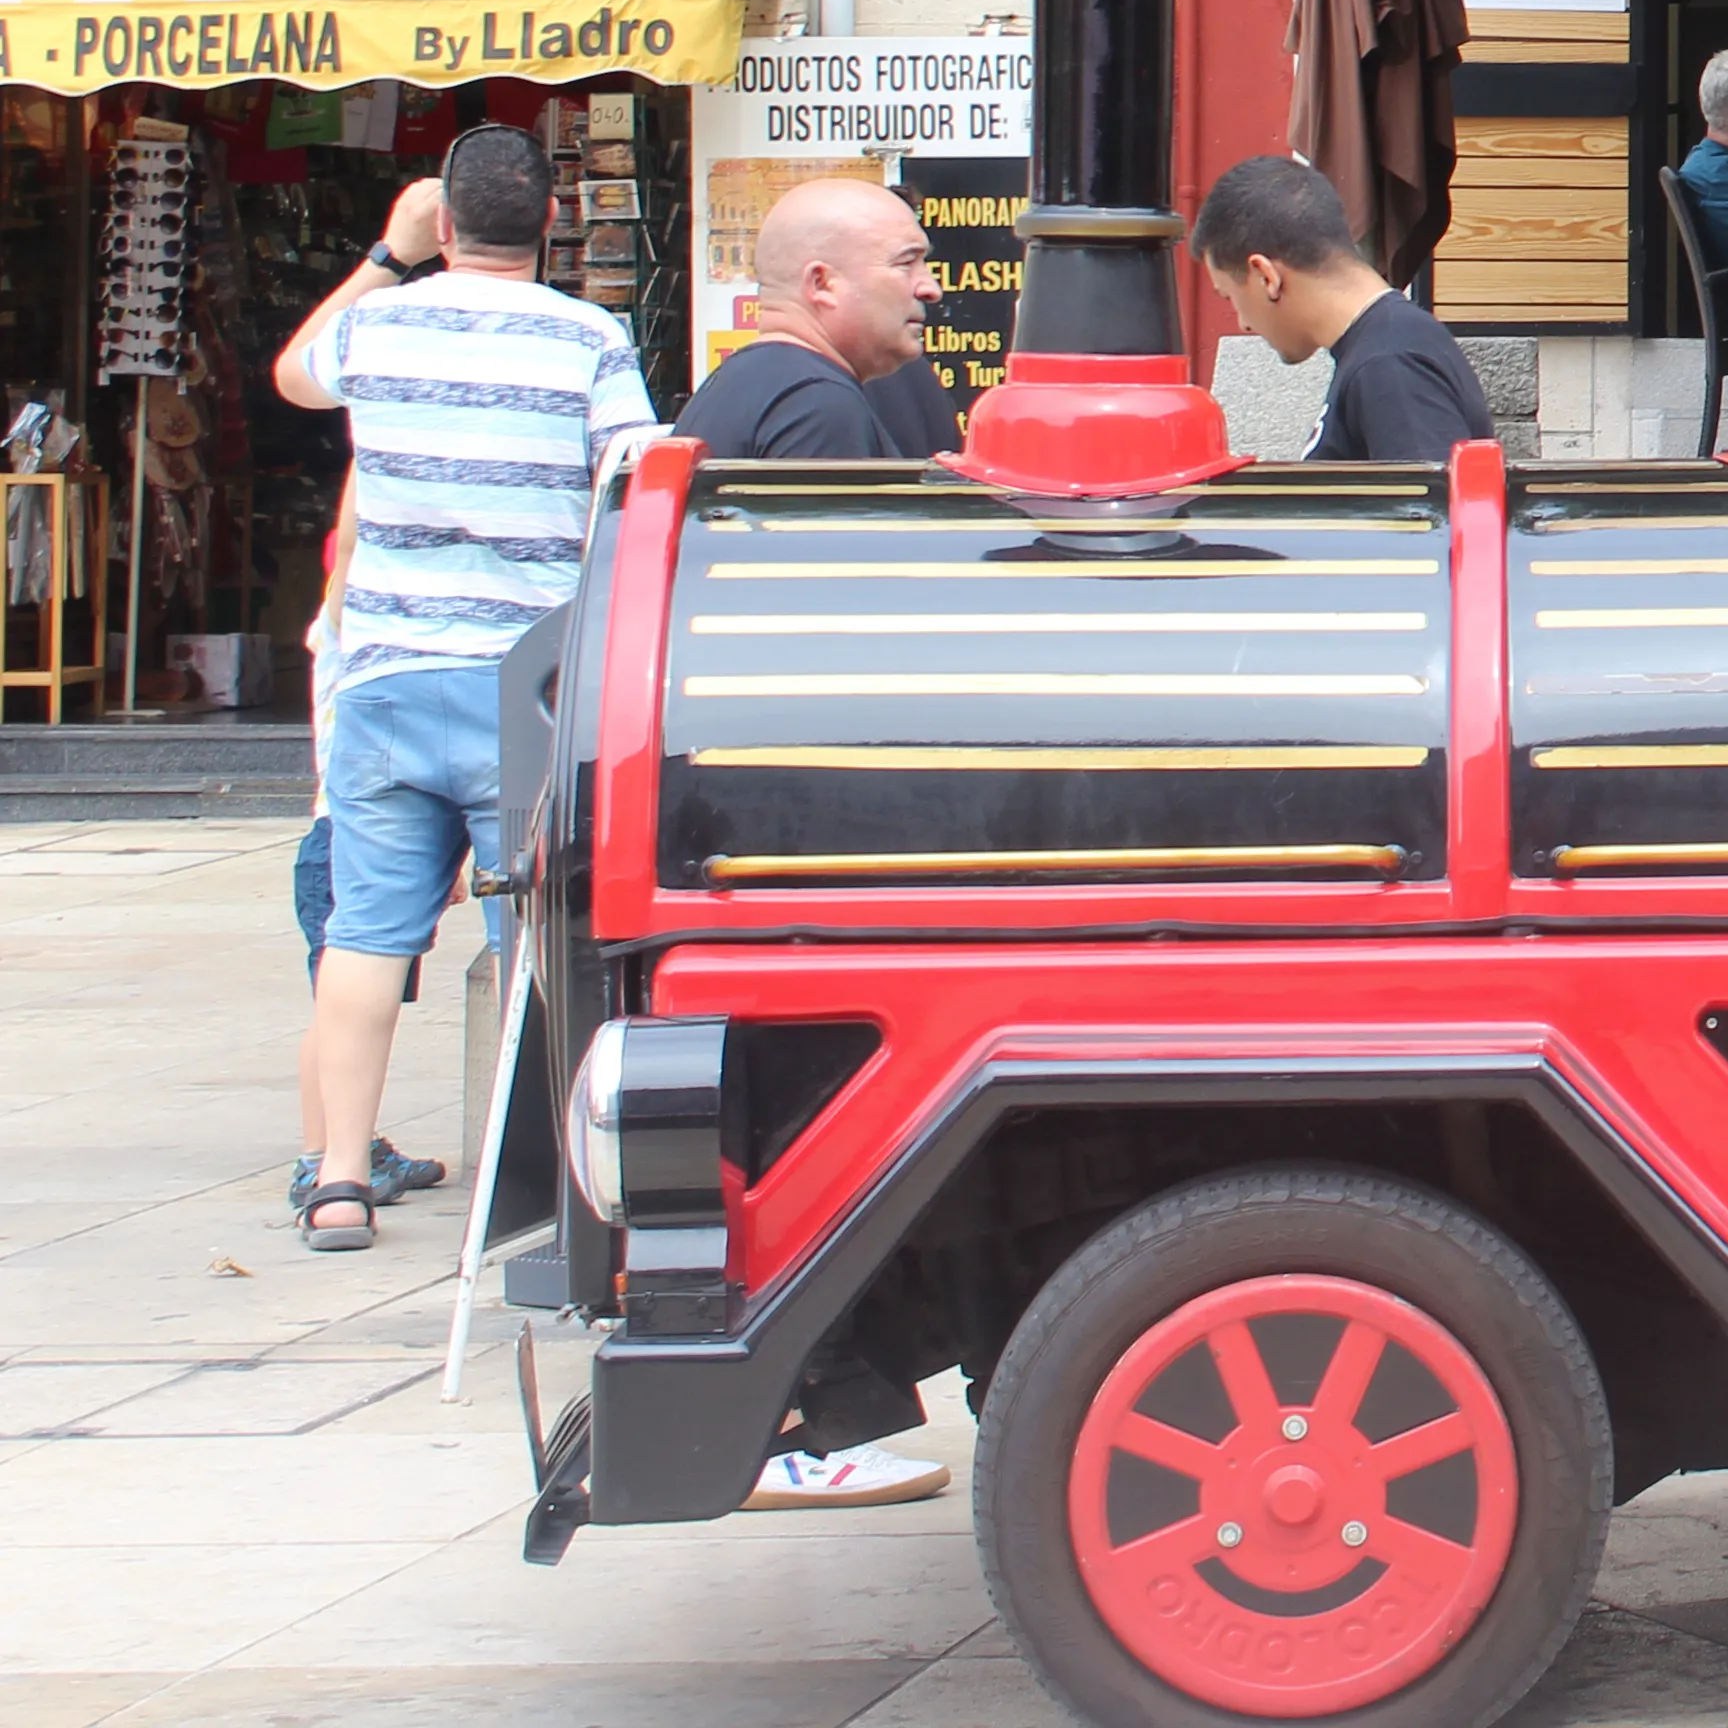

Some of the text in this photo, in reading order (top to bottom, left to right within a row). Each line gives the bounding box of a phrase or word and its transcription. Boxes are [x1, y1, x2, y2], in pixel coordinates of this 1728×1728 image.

[74, 11, 342, 76] PORCELANA
[414, 26, 471, 70] By
[480, 7, 675, 61] Lladro
[708, 55, 1032, 93] ODUCTOS FOTOGRAFIC
[768, 103, 1008, 141] DISTRIBUIDOR DE:
[924, 196, 1030, 228] PANORAM
[925, 260, 1024, 292] FLASH
[924, 325, 1002, 353] Libros
[964, 360, 1006, 388] Tur
